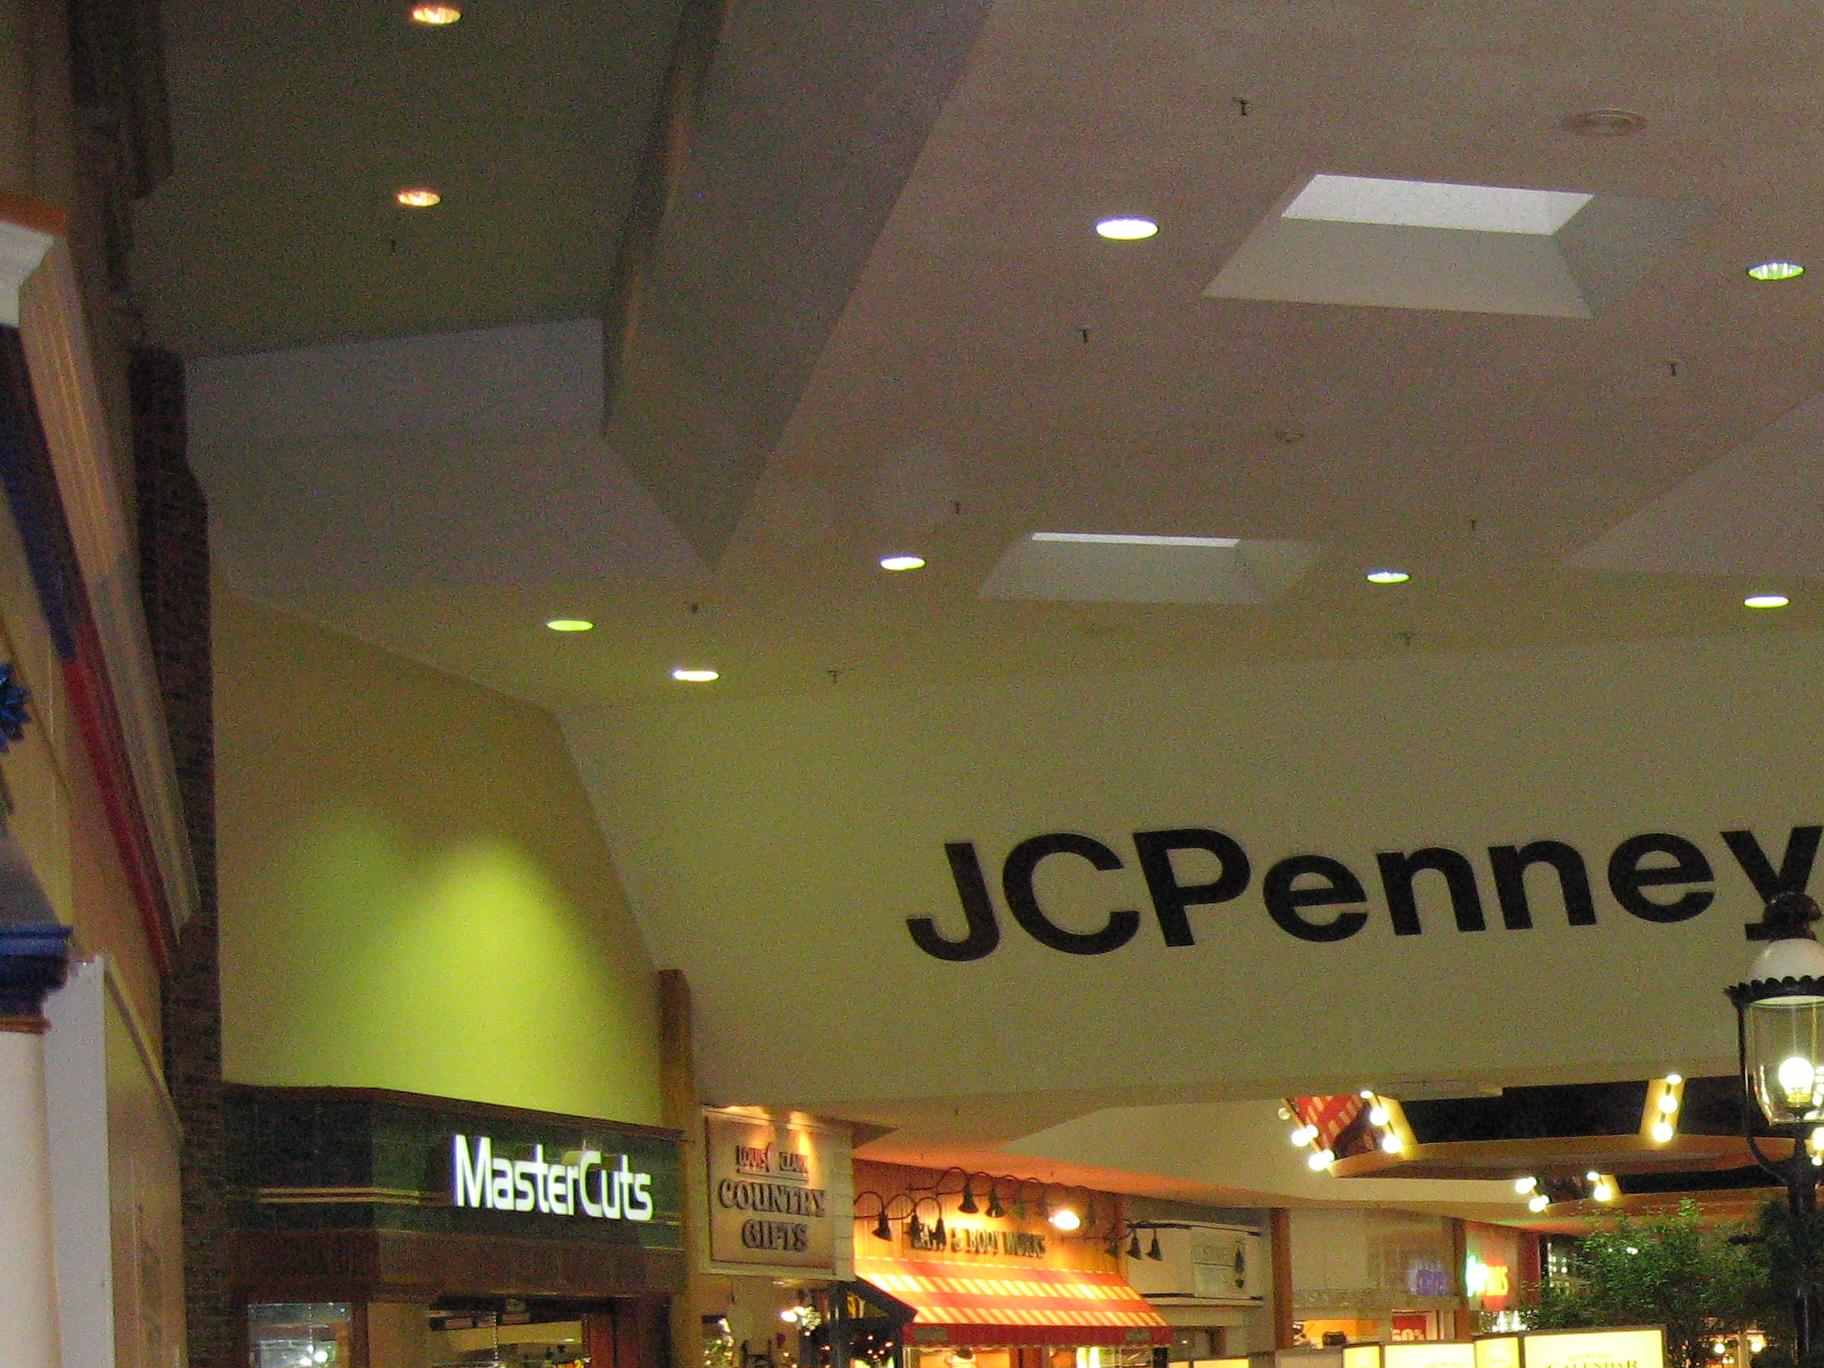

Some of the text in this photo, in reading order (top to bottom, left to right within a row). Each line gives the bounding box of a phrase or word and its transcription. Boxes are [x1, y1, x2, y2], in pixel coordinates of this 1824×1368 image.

[905, 824, 1824, 962] JCPenney
[453, 1133, 654, 1222] MasterCuts
[719, 1178, 826, 1218] COUNTRY
[742, 1218, 810, 1252] GIFTS
